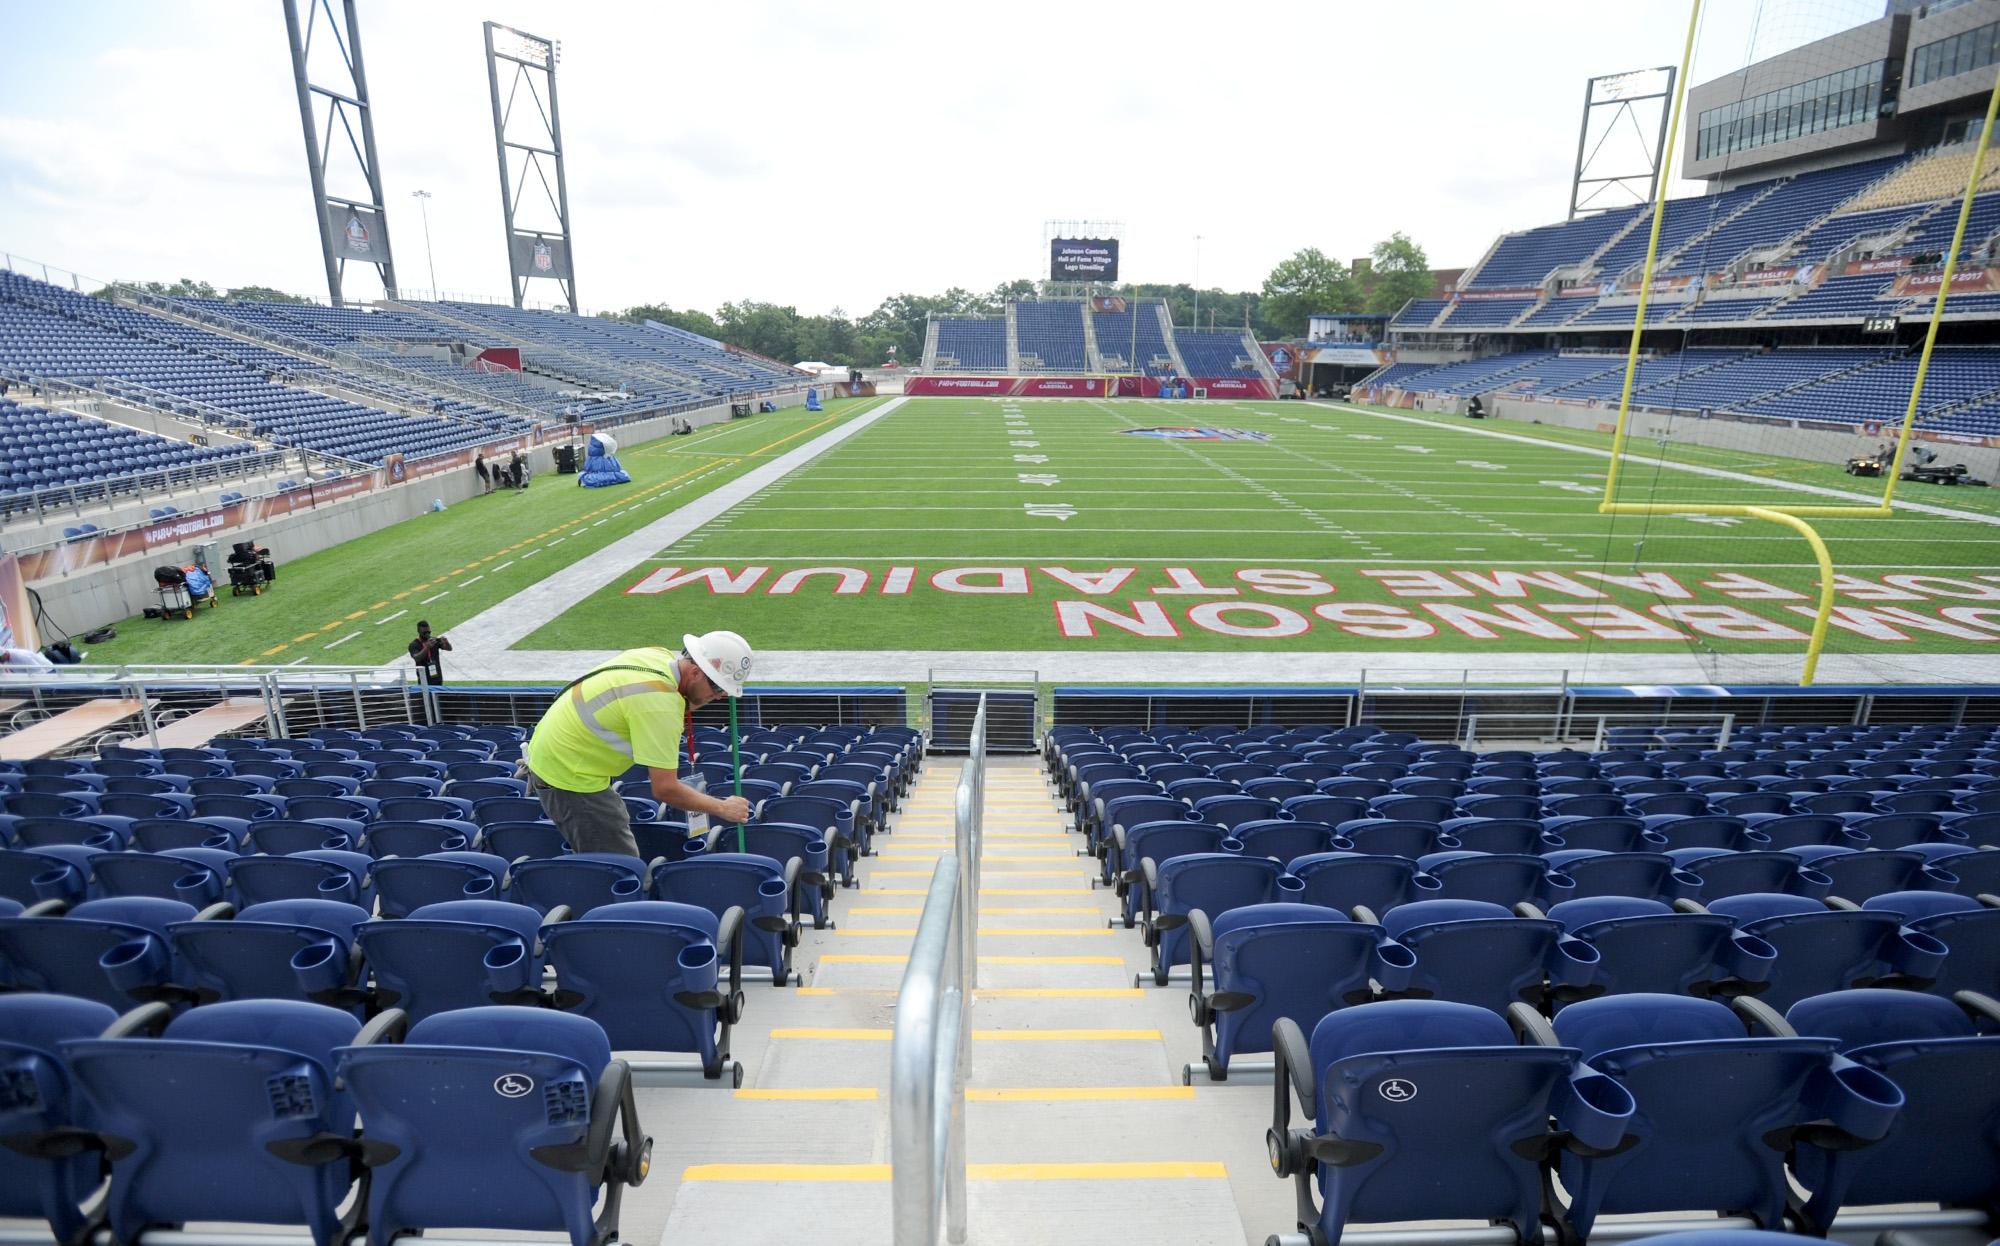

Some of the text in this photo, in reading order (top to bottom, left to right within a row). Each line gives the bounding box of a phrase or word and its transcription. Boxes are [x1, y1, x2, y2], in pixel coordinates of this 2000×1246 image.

[1959, 272, 1984, 281] 2017
[624, 565, 1337, 596] STADIUM
[1357, 569, 1814, 600] FAME
[1053, 600, 1814, 640] BENSON
